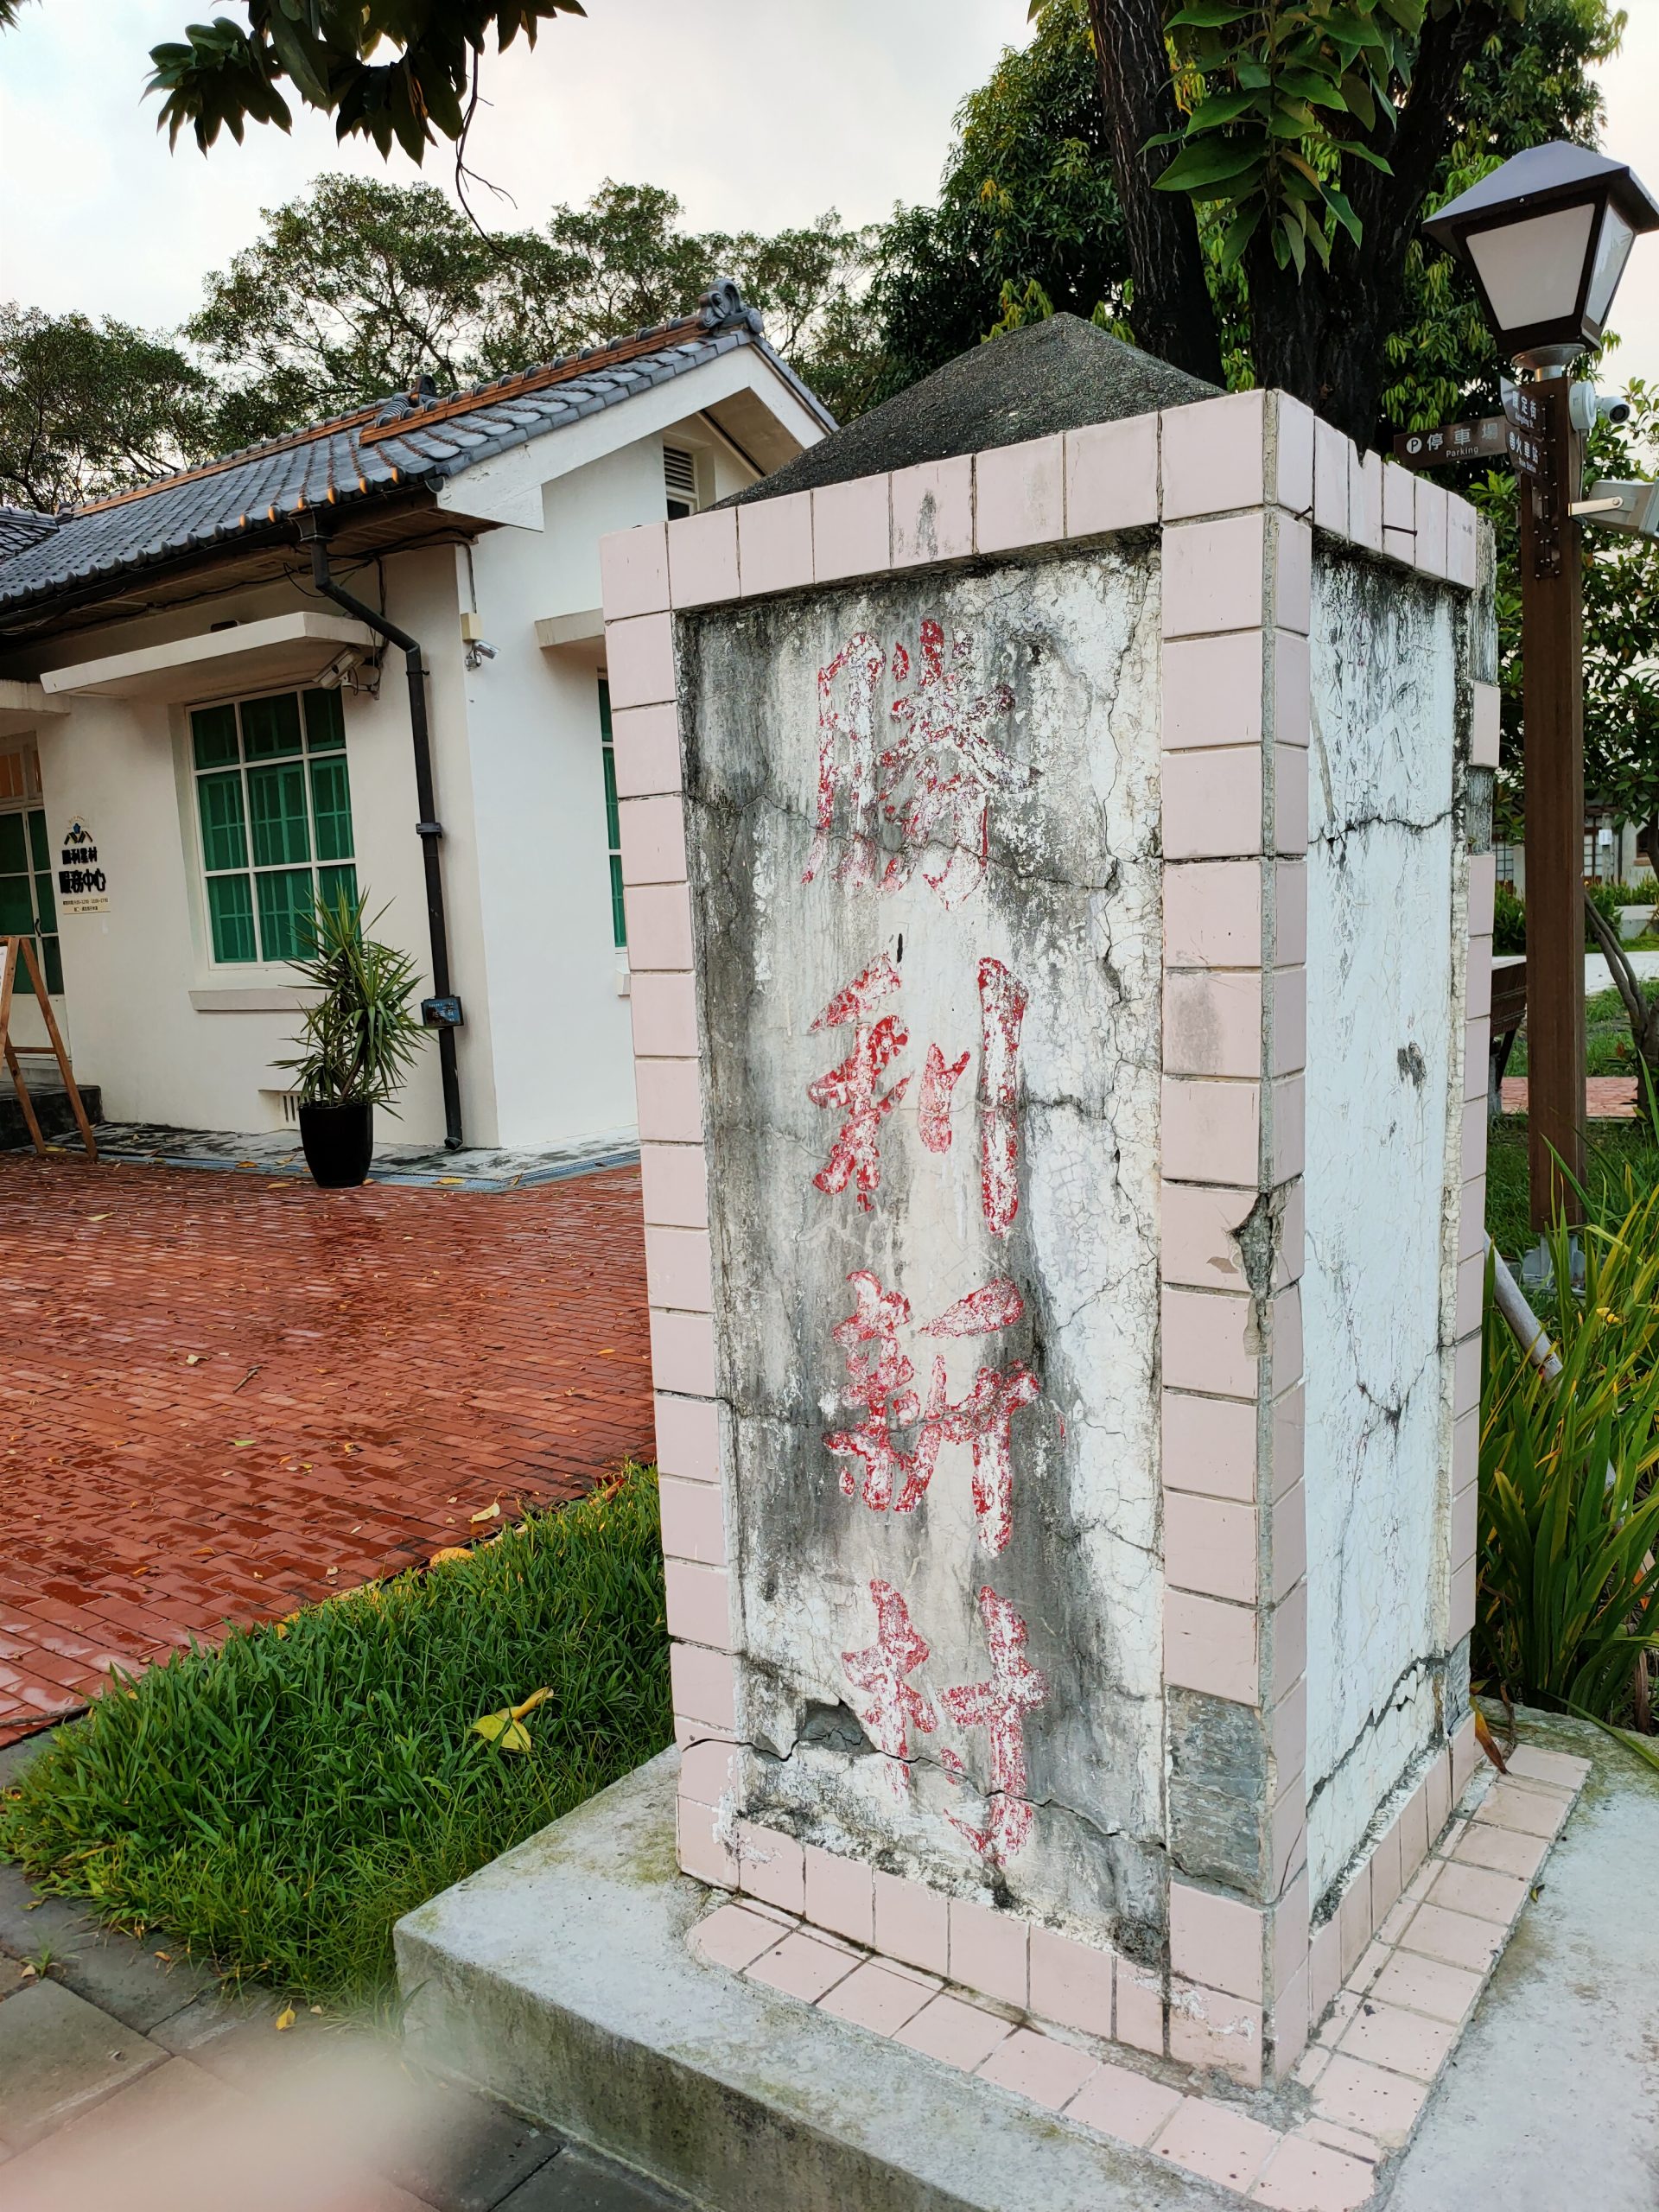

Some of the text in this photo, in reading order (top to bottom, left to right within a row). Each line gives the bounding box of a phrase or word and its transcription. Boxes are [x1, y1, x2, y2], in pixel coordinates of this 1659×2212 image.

[1427, 423, 1498, 451] 停車場
[1516, 435, 1538, 464] 火車站
[1446, 446, 1479, 458] Parking
[803, 619, 1044, 1865] 勝利新村
